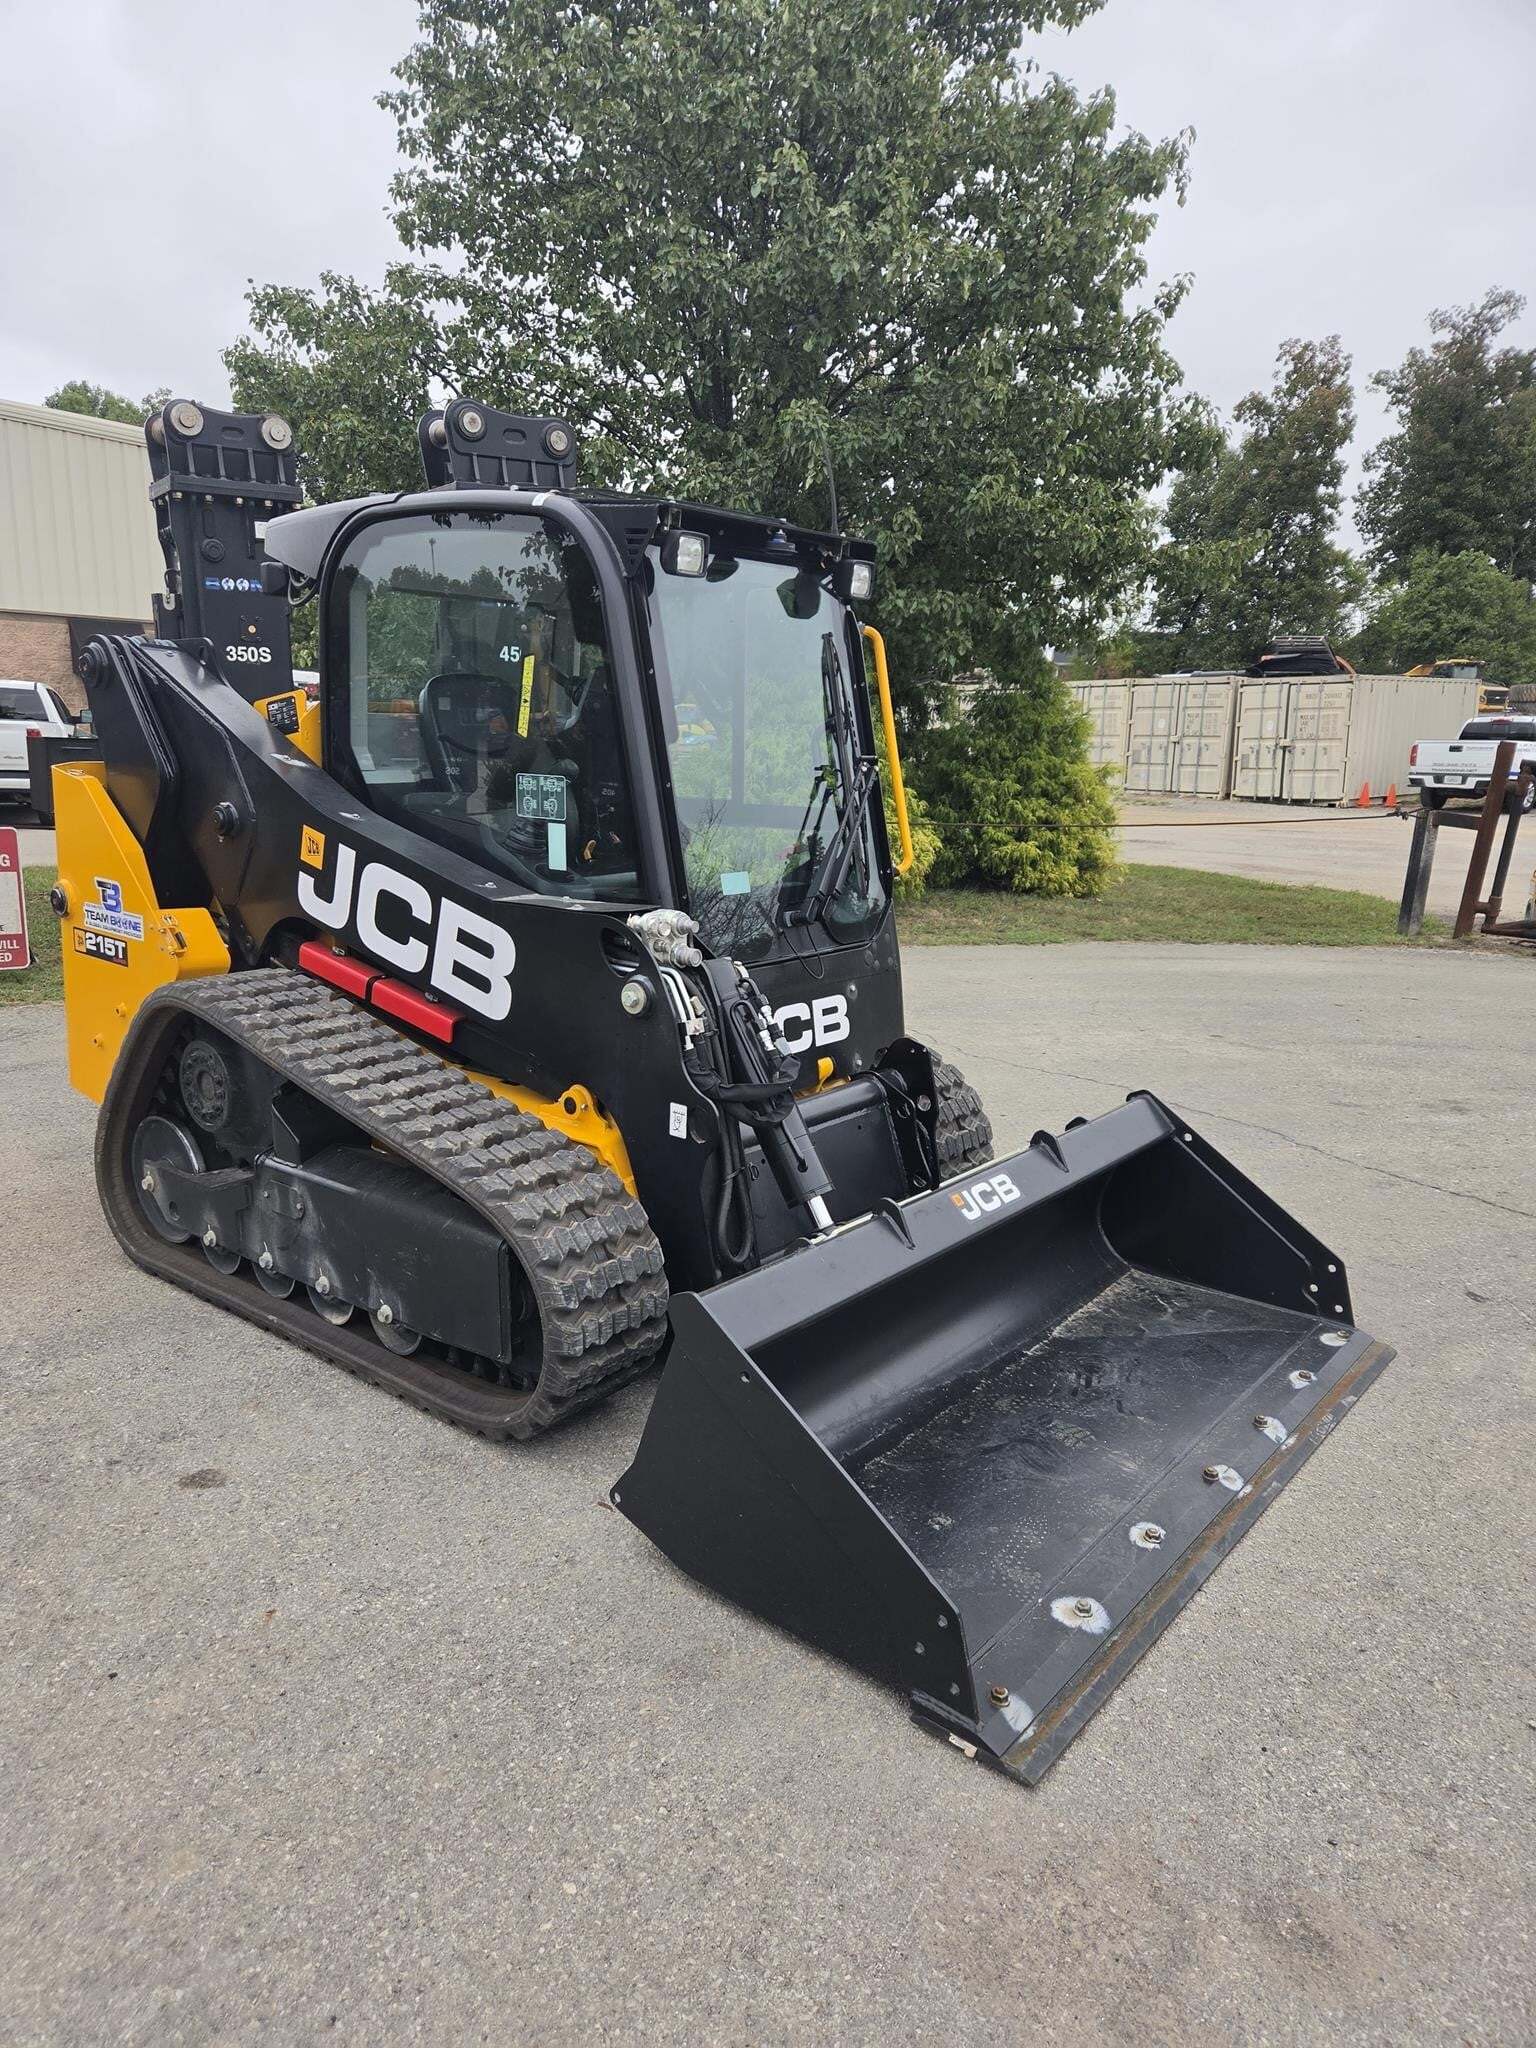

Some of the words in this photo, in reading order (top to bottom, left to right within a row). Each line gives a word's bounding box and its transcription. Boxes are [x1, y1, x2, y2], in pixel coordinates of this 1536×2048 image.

[226, 645, 272, 663] 350S
[500, 645, 521, 662] 45
[85, 909, 108, 922] TEAM
[85, 931, 126, 959] 215T
[298, 843, 516, 1021] JCB
[773, 994, 850, 1054] CB
[961, 1174, 1021, 1220] JCB
